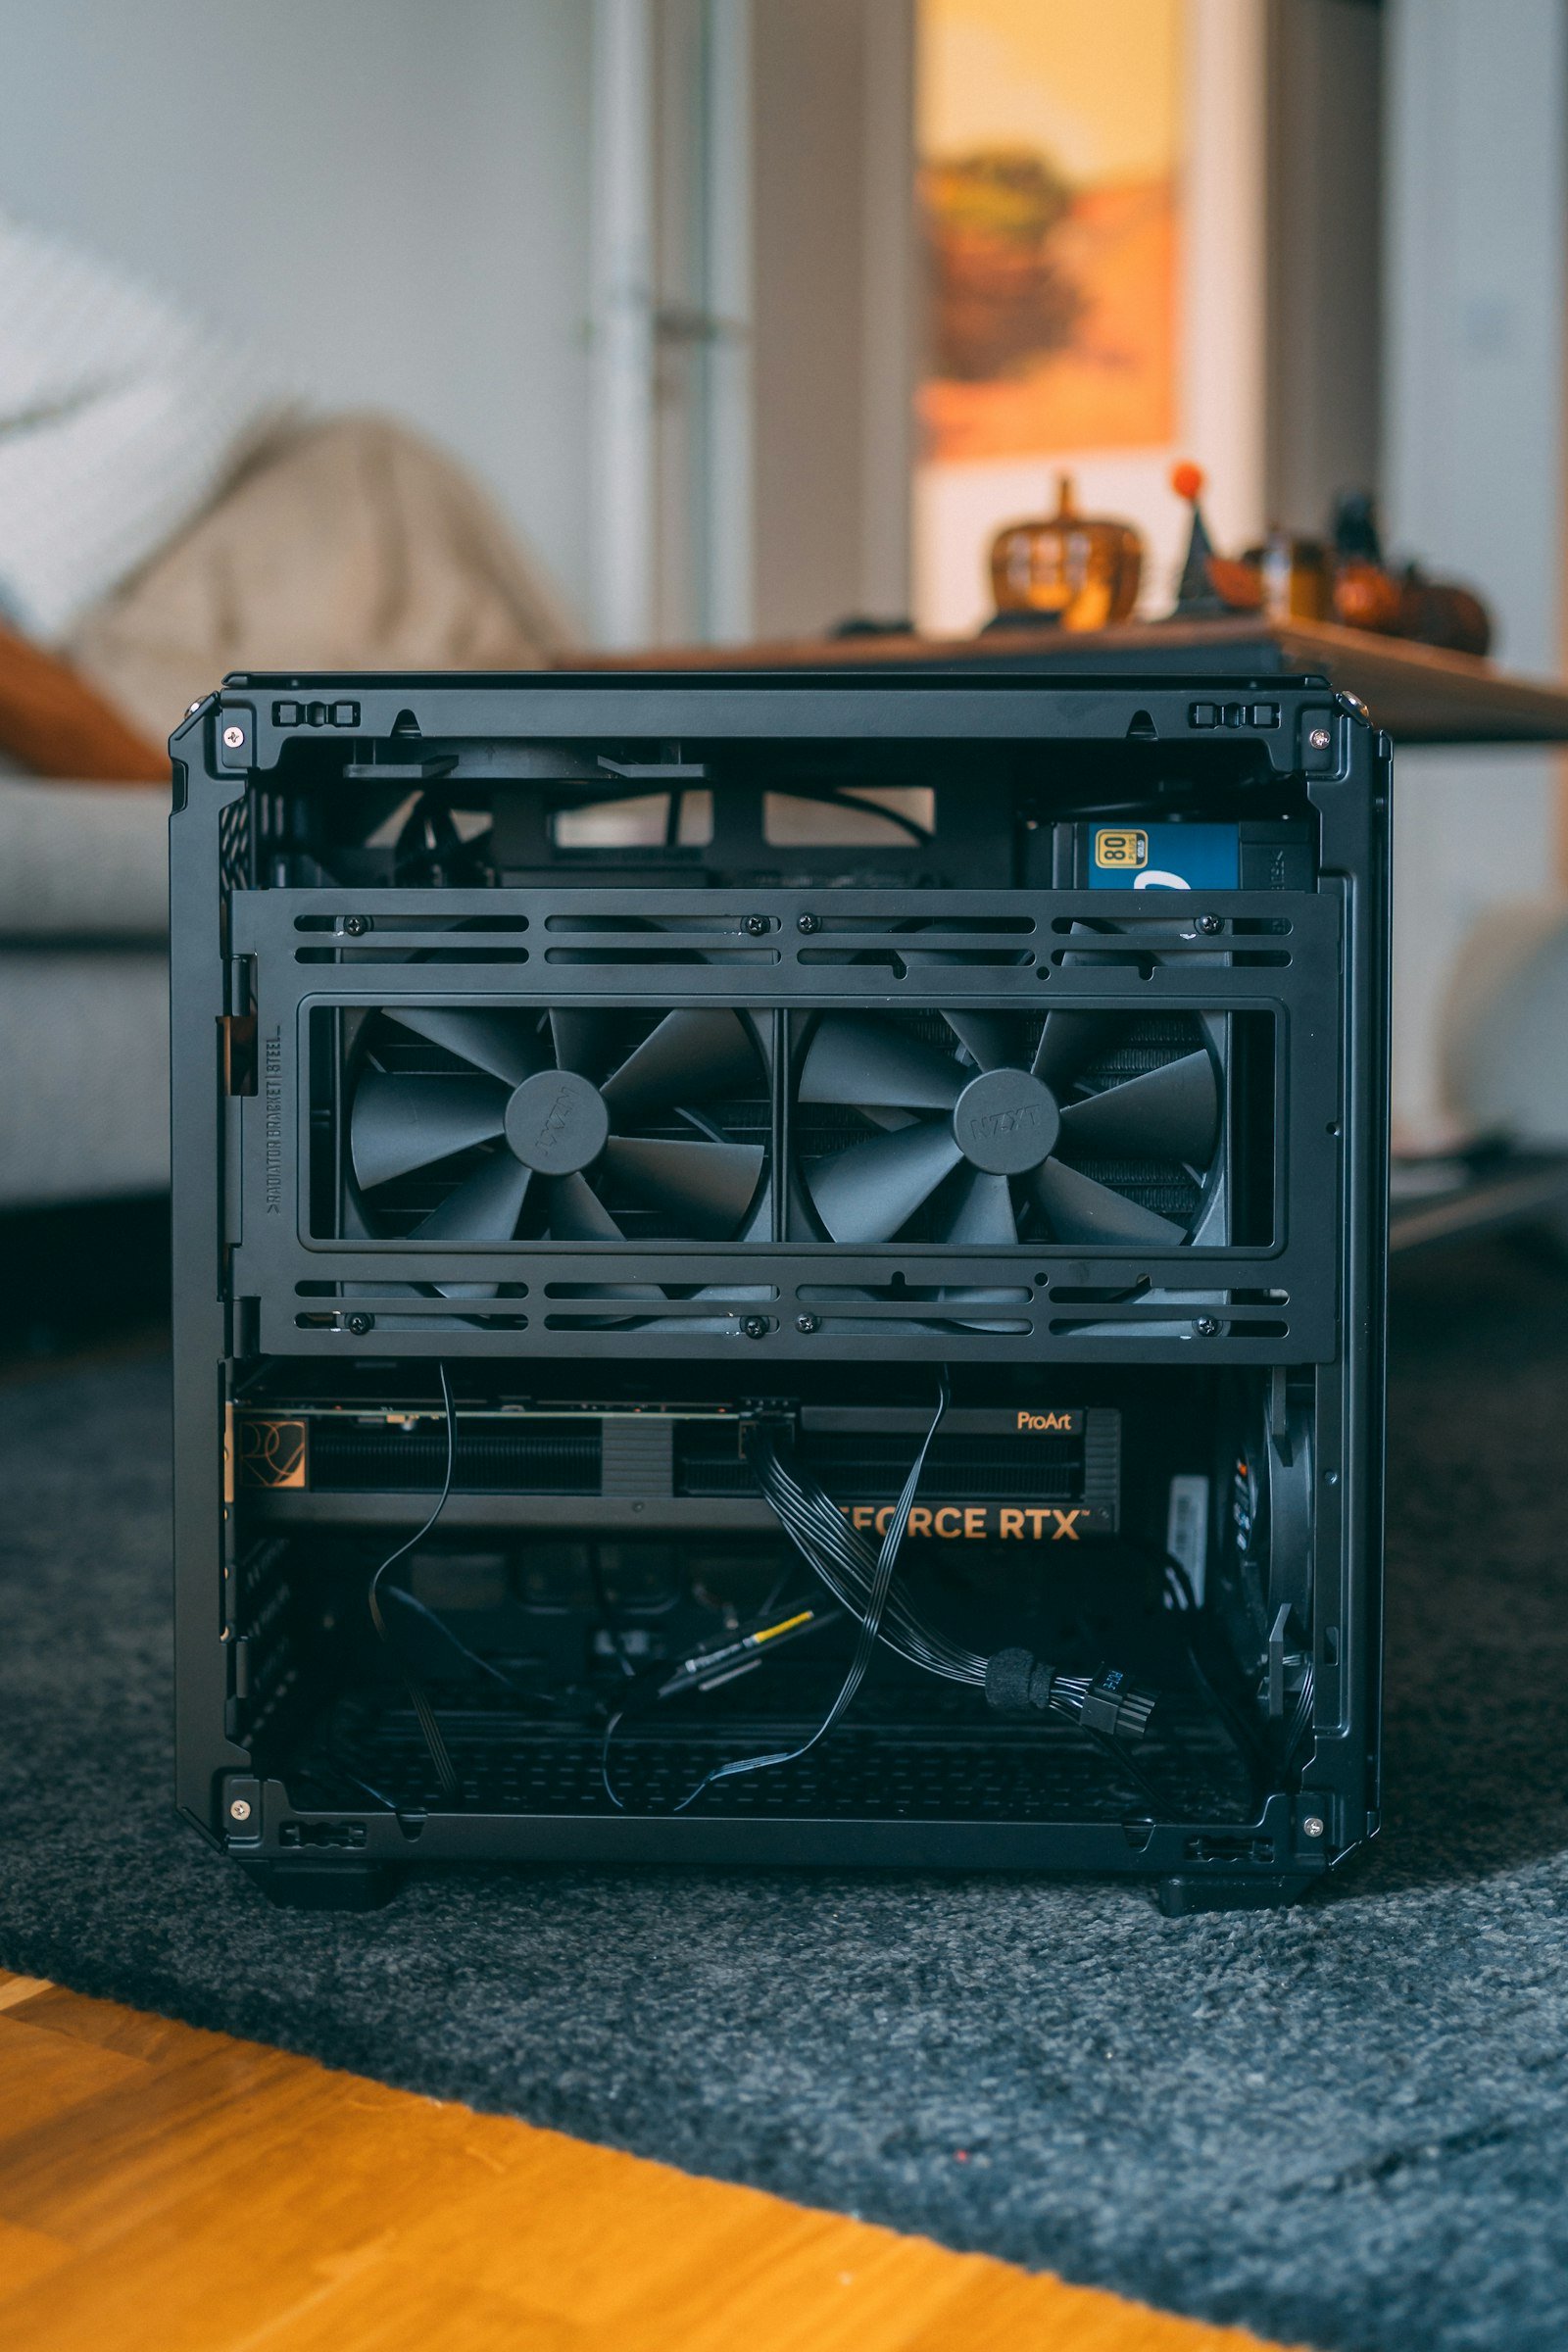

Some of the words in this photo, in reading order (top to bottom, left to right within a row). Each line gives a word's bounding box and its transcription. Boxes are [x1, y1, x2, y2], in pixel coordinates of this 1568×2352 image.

[1103, 837, 1126, 860] 80
[970, 1103, 1043, 1141] NZXT
[1017, 1411, 1071, 1430] ProArt
[839, 1506, 987, 1539] FORCE
